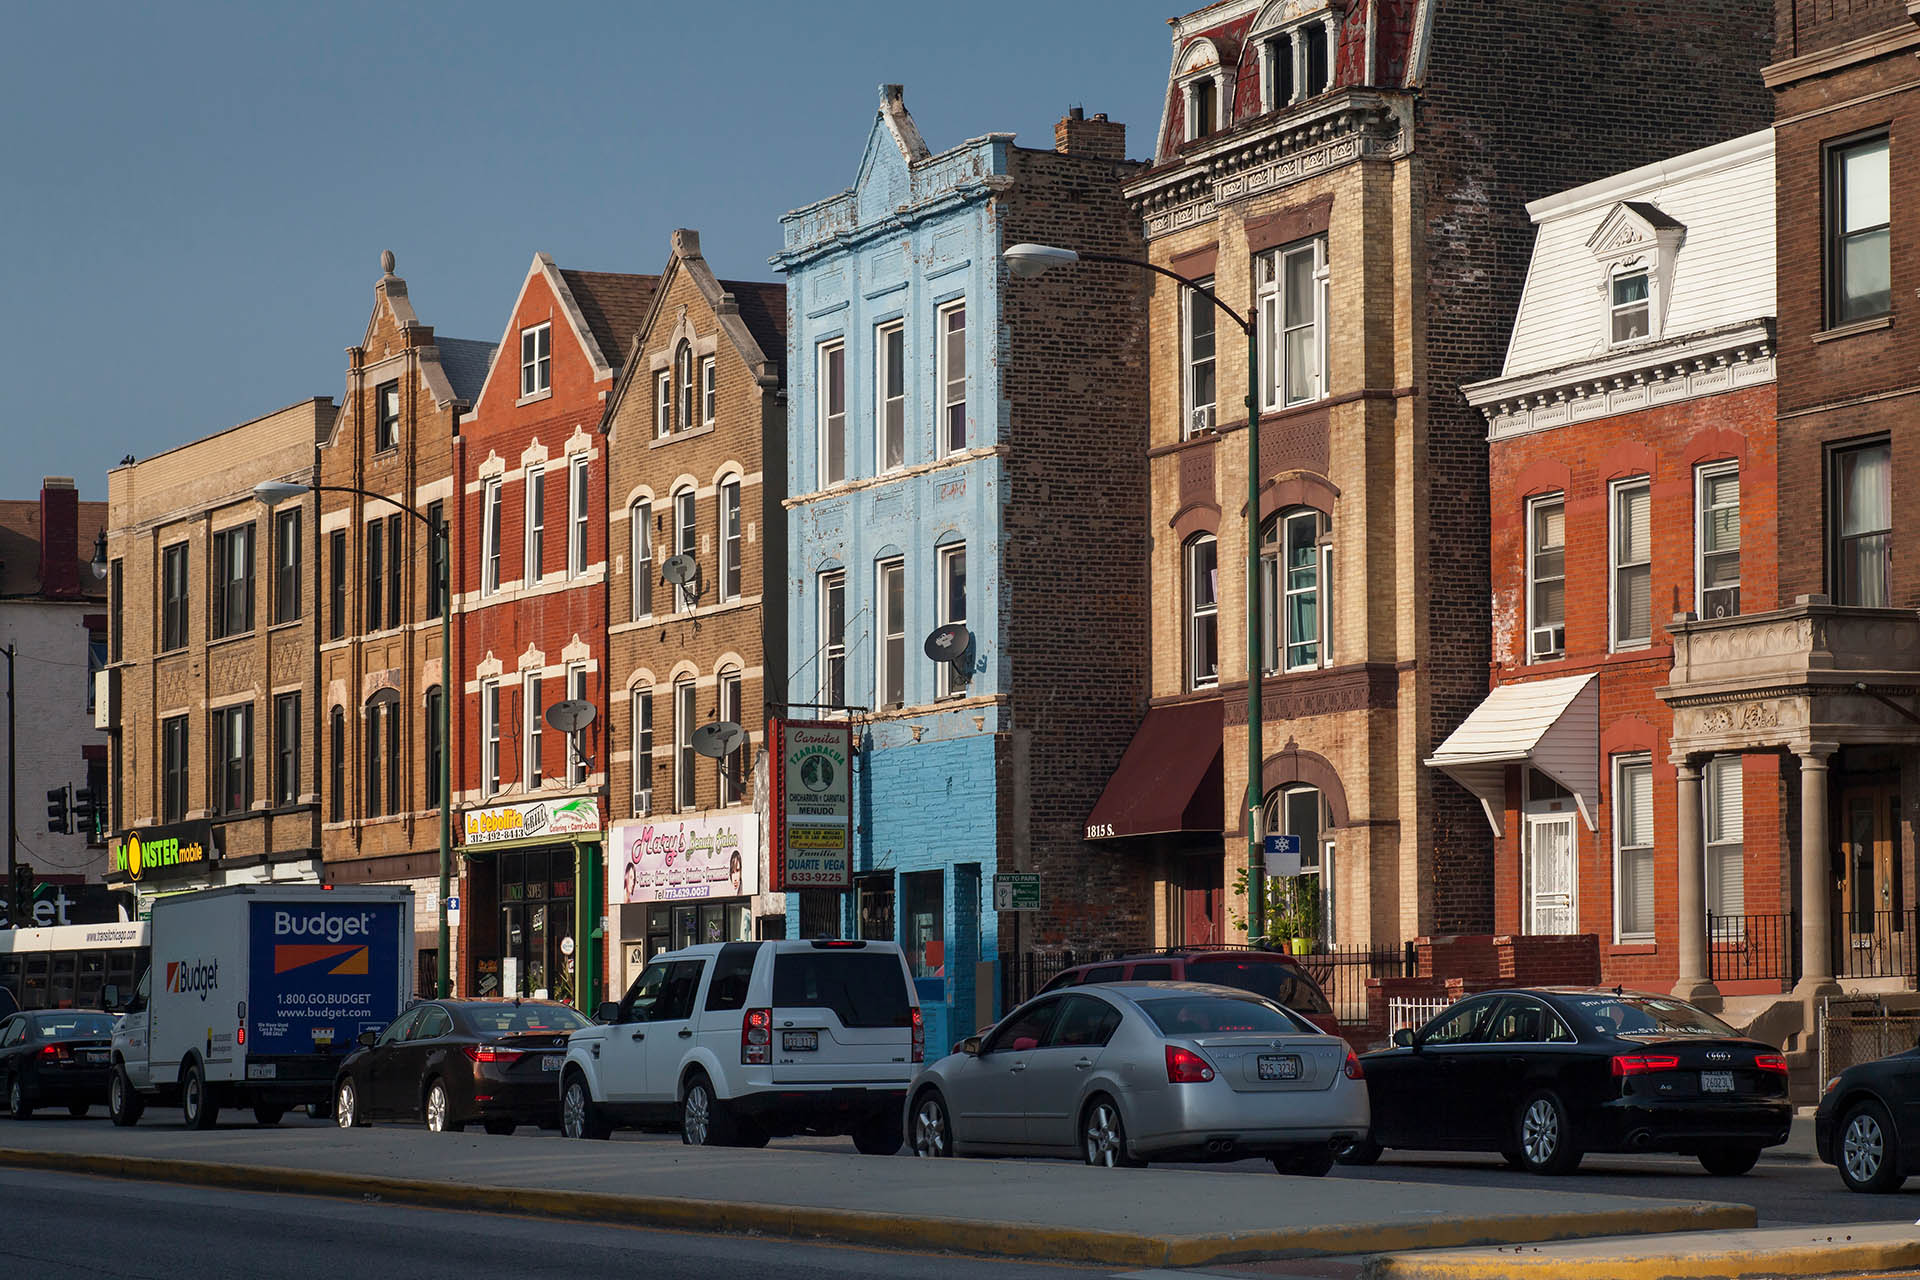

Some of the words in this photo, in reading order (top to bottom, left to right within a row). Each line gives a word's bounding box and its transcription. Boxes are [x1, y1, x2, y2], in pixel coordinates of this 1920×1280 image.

[794, 730, 841, 745] Carnitas
[790, 744, 845, 766] TZARARACUA
[799, 806, 834, 815] MENUDO
[467, 813, 479, 835] La
[480, 808, 523, 832] Cebollita
[1087, 824, 1106, 838] 1815
[1107, 823, 1115, 836] S.
[631, 822, 686, 867] Mary's
[685, 830, 715, 862] Beauty
[715, 827, 738, 855] Salon
[178, 843, 202, 863] mobile
[788, 860, 819, 871] DUARTE
[823, 860, 845, 871] VEGA
[791, 873, 841, 882] 633-9225
[274, 911, 369, 943] Budget
[180, 959, 218, 1002] Budget
[277, 993, 371, 1005] 1.800.GO.BUDGET
[276, 1007, 371, 1020] www.budget.com
